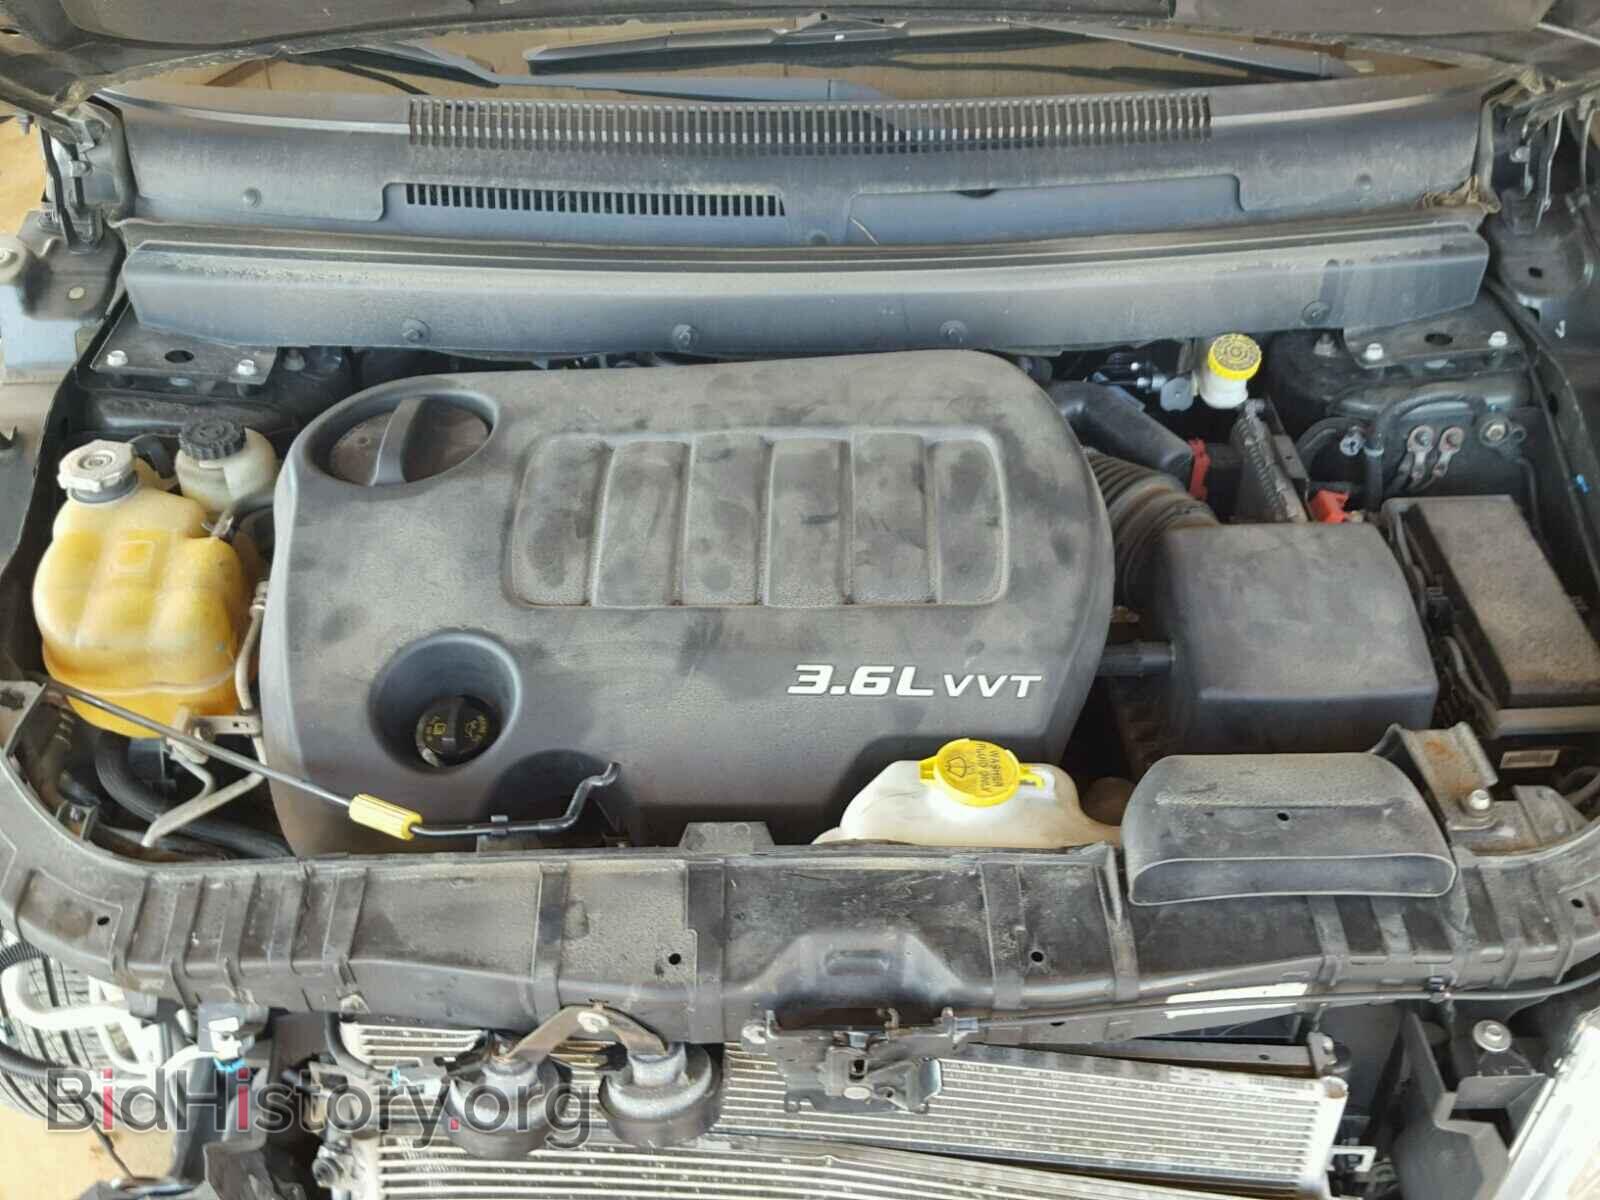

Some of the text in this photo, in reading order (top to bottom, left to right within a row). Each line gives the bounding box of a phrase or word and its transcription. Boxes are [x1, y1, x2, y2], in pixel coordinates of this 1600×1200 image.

[787, 664, 1043, 698] 3.6L VVT
[976, 743, 992, 793] FLUID ONLY
[989, 750, 1004, 787] WASHER
